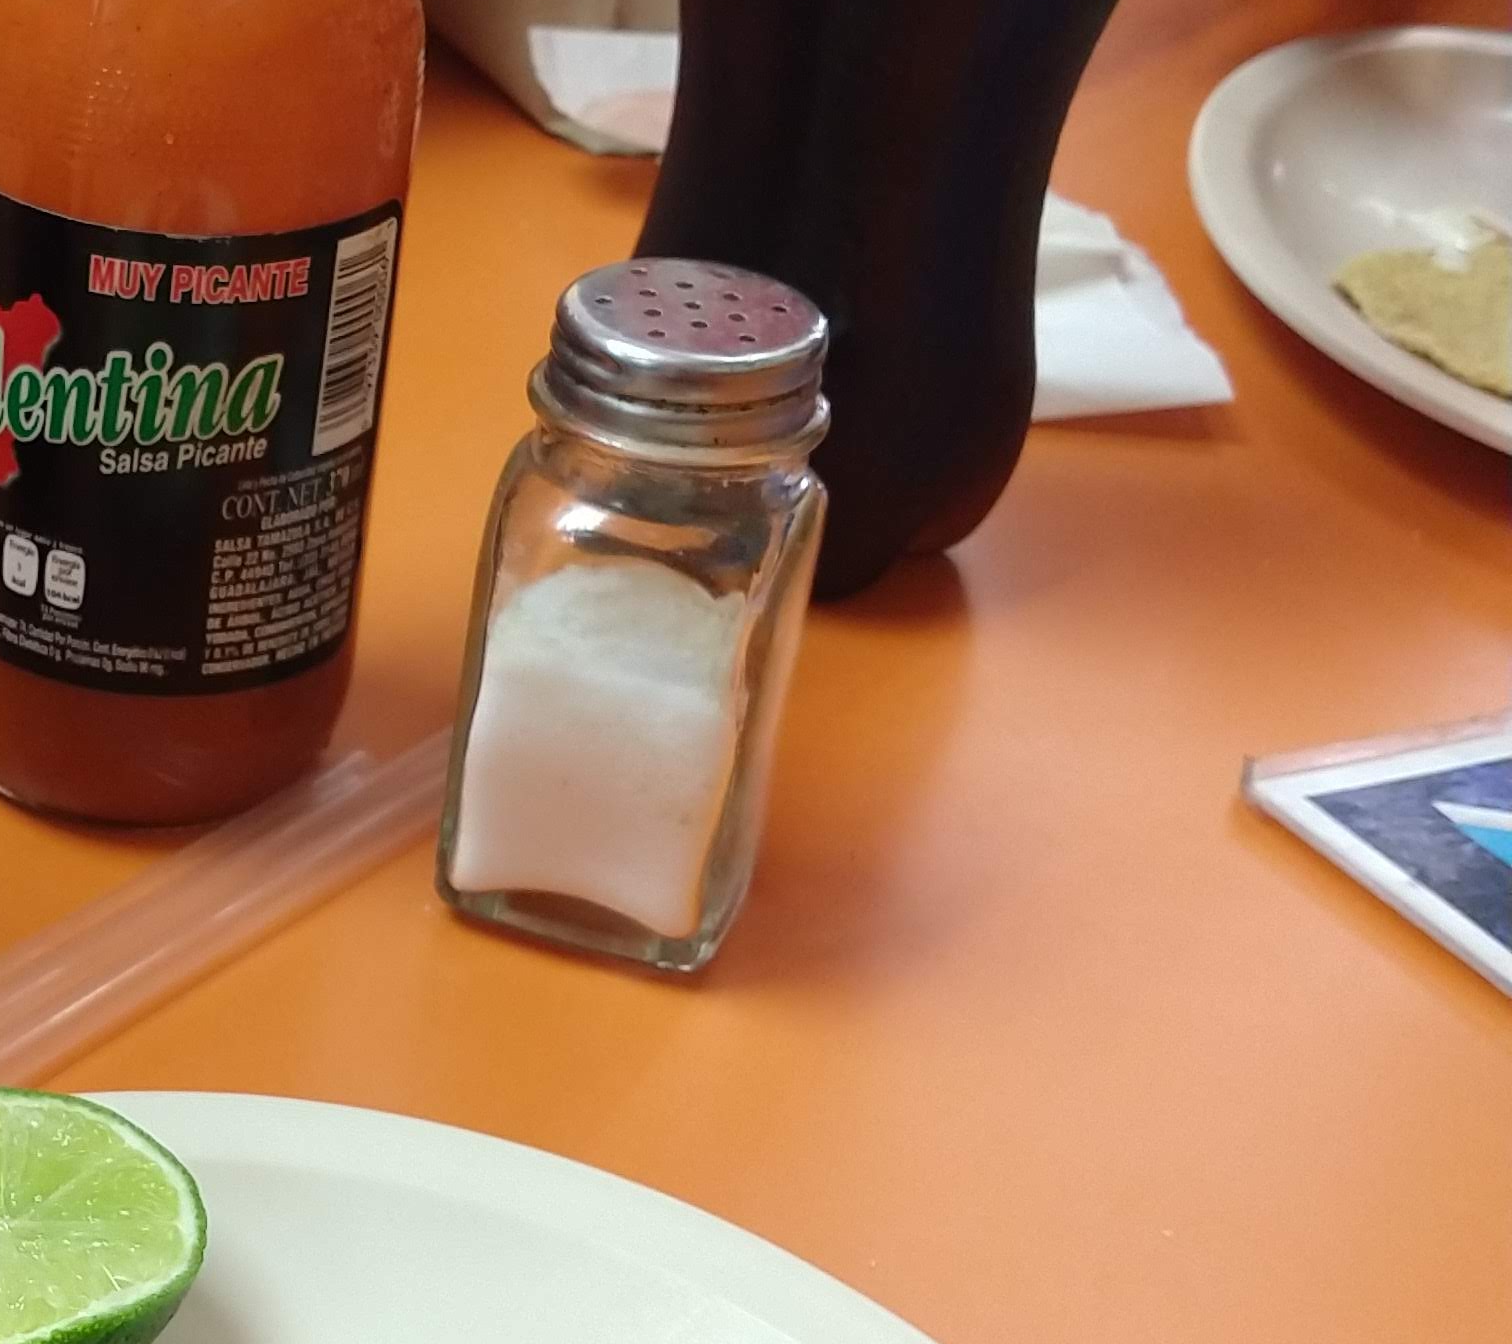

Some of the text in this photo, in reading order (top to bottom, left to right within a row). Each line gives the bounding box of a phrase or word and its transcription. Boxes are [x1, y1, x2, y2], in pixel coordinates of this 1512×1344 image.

[89, 254, 311, 305] MUY PICANTE
[98, 447, 169, 475] Salsa
[177, 437, 269, 470] Picante
